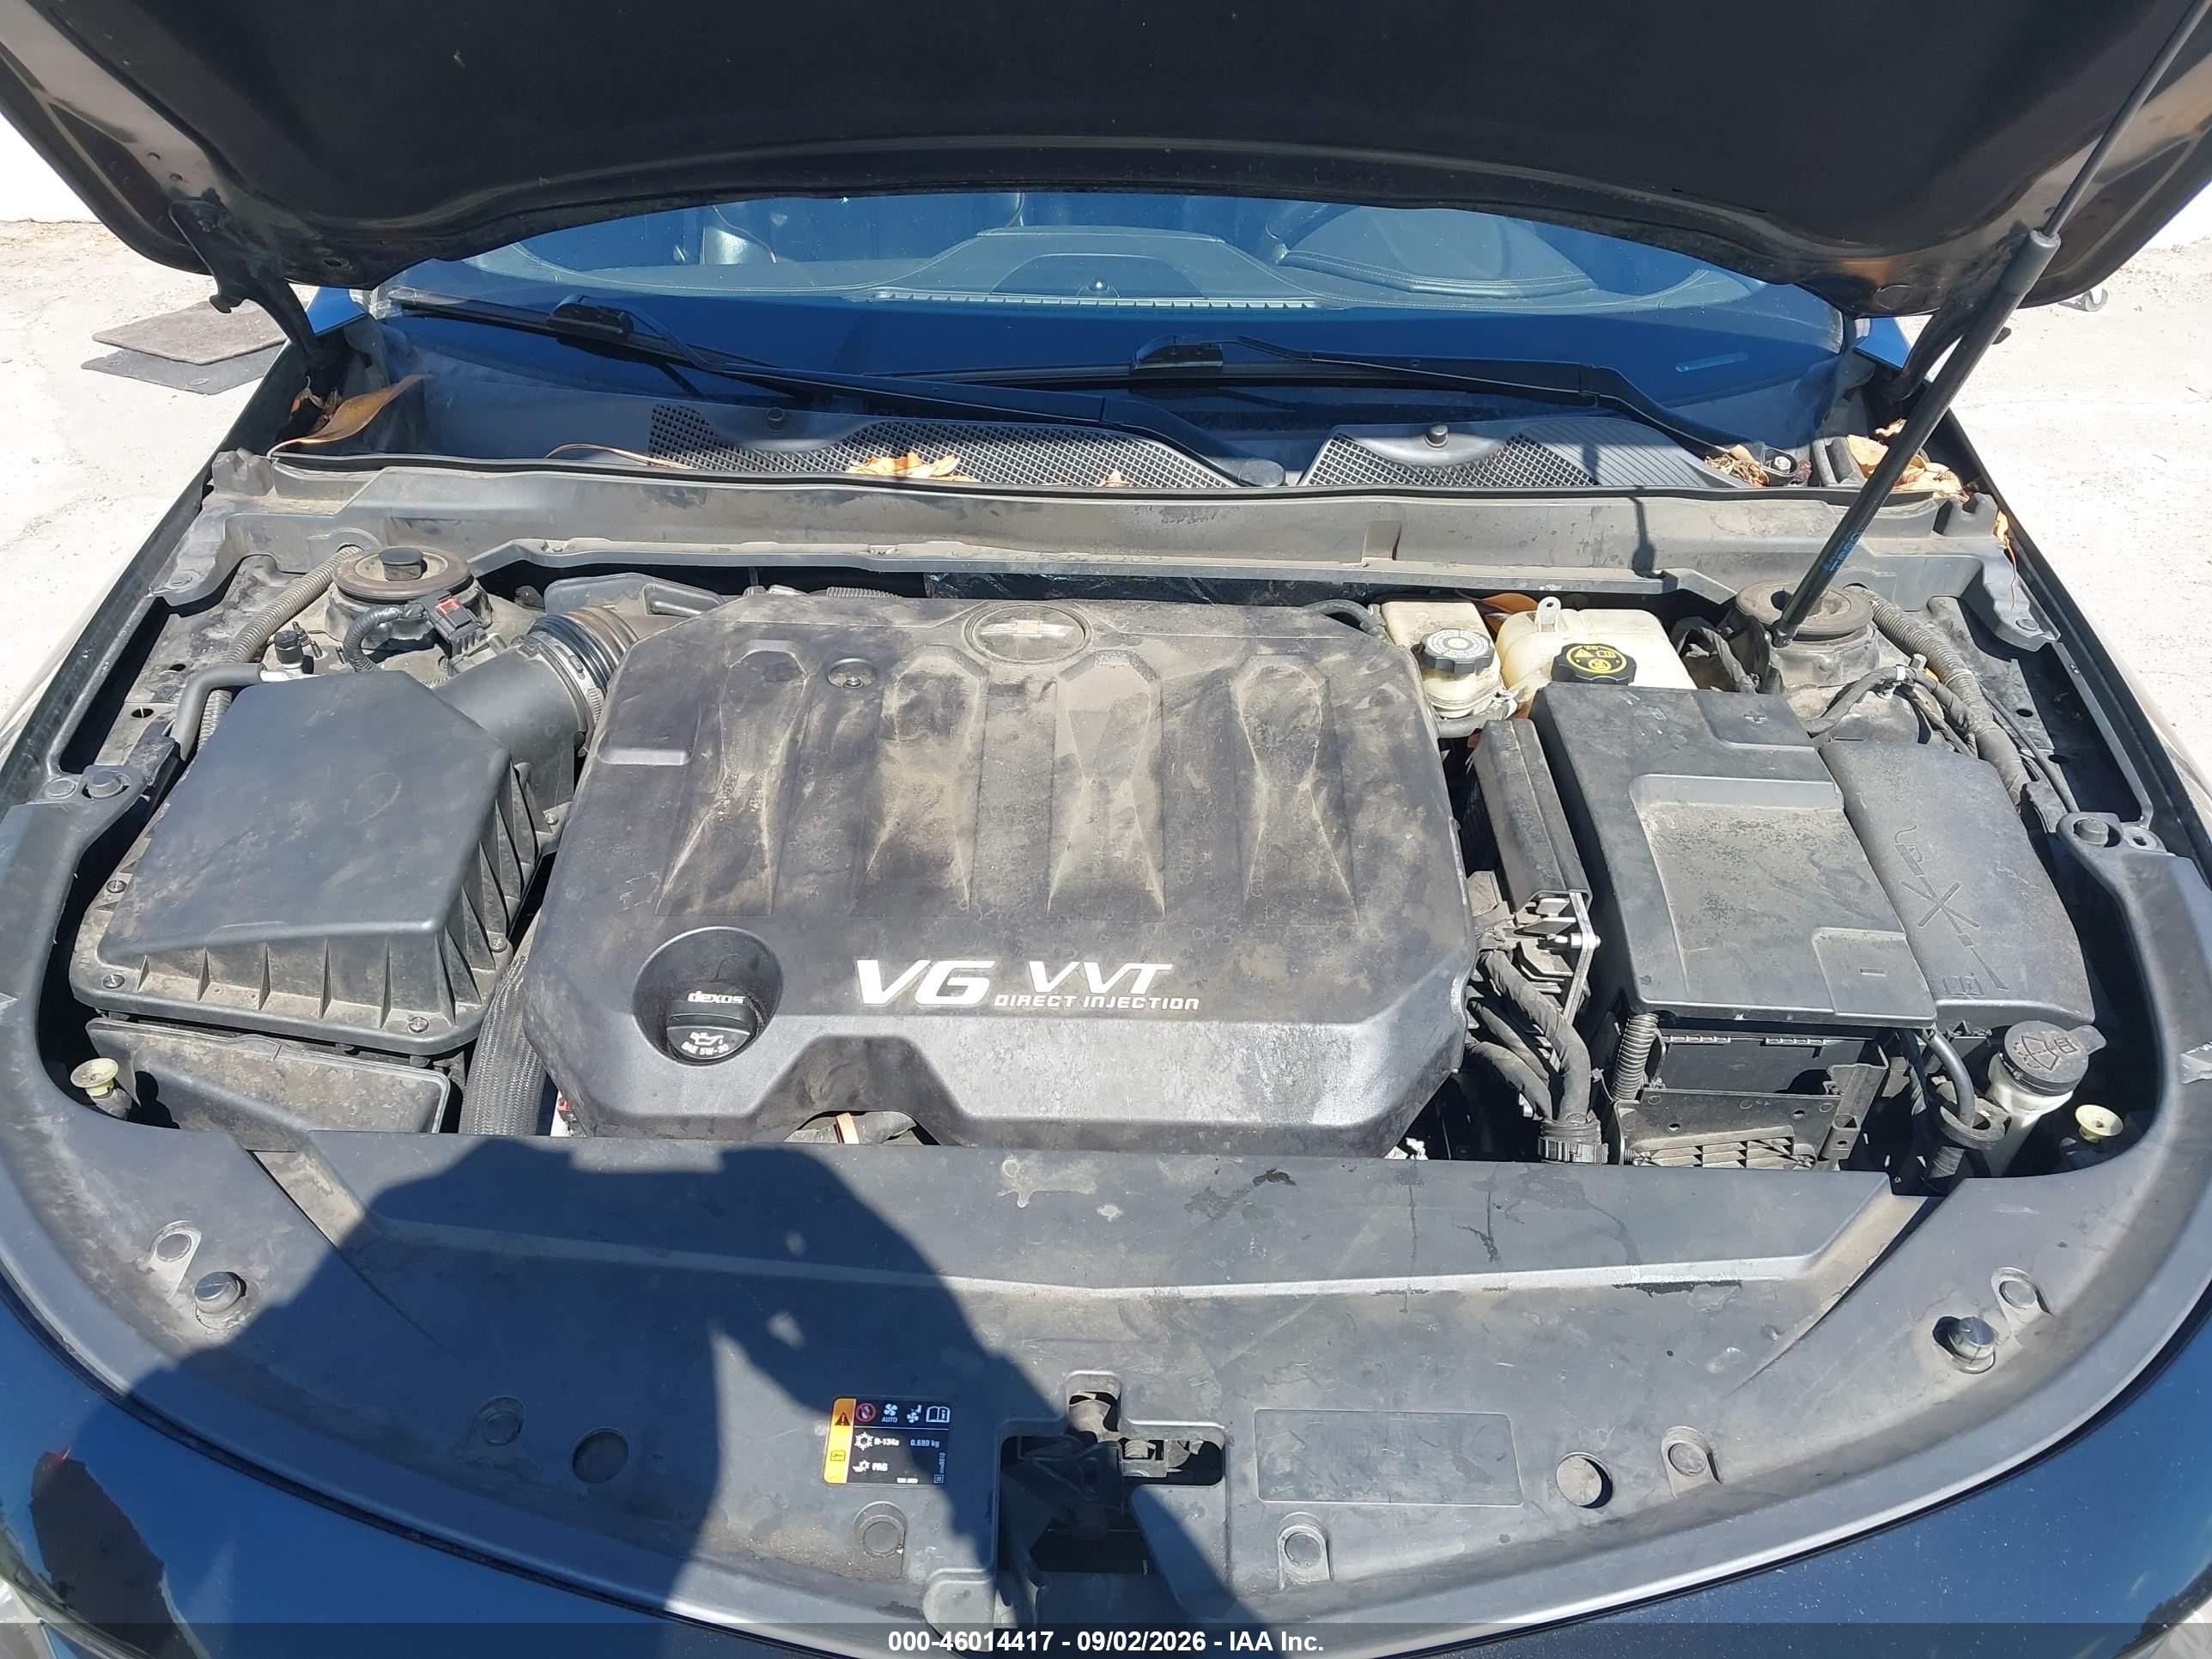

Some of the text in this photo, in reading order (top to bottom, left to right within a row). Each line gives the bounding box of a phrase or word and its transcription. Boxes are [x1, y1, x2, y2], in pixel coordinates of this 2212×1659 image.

[857, 960, 1173, 1005] V6 VVT
[688, 991, 745, 1004] dexos
[994, 994, 1200, 1011] DIRECT INJECTION
[681, 1041, 729, 1055] SAE 5W-30
